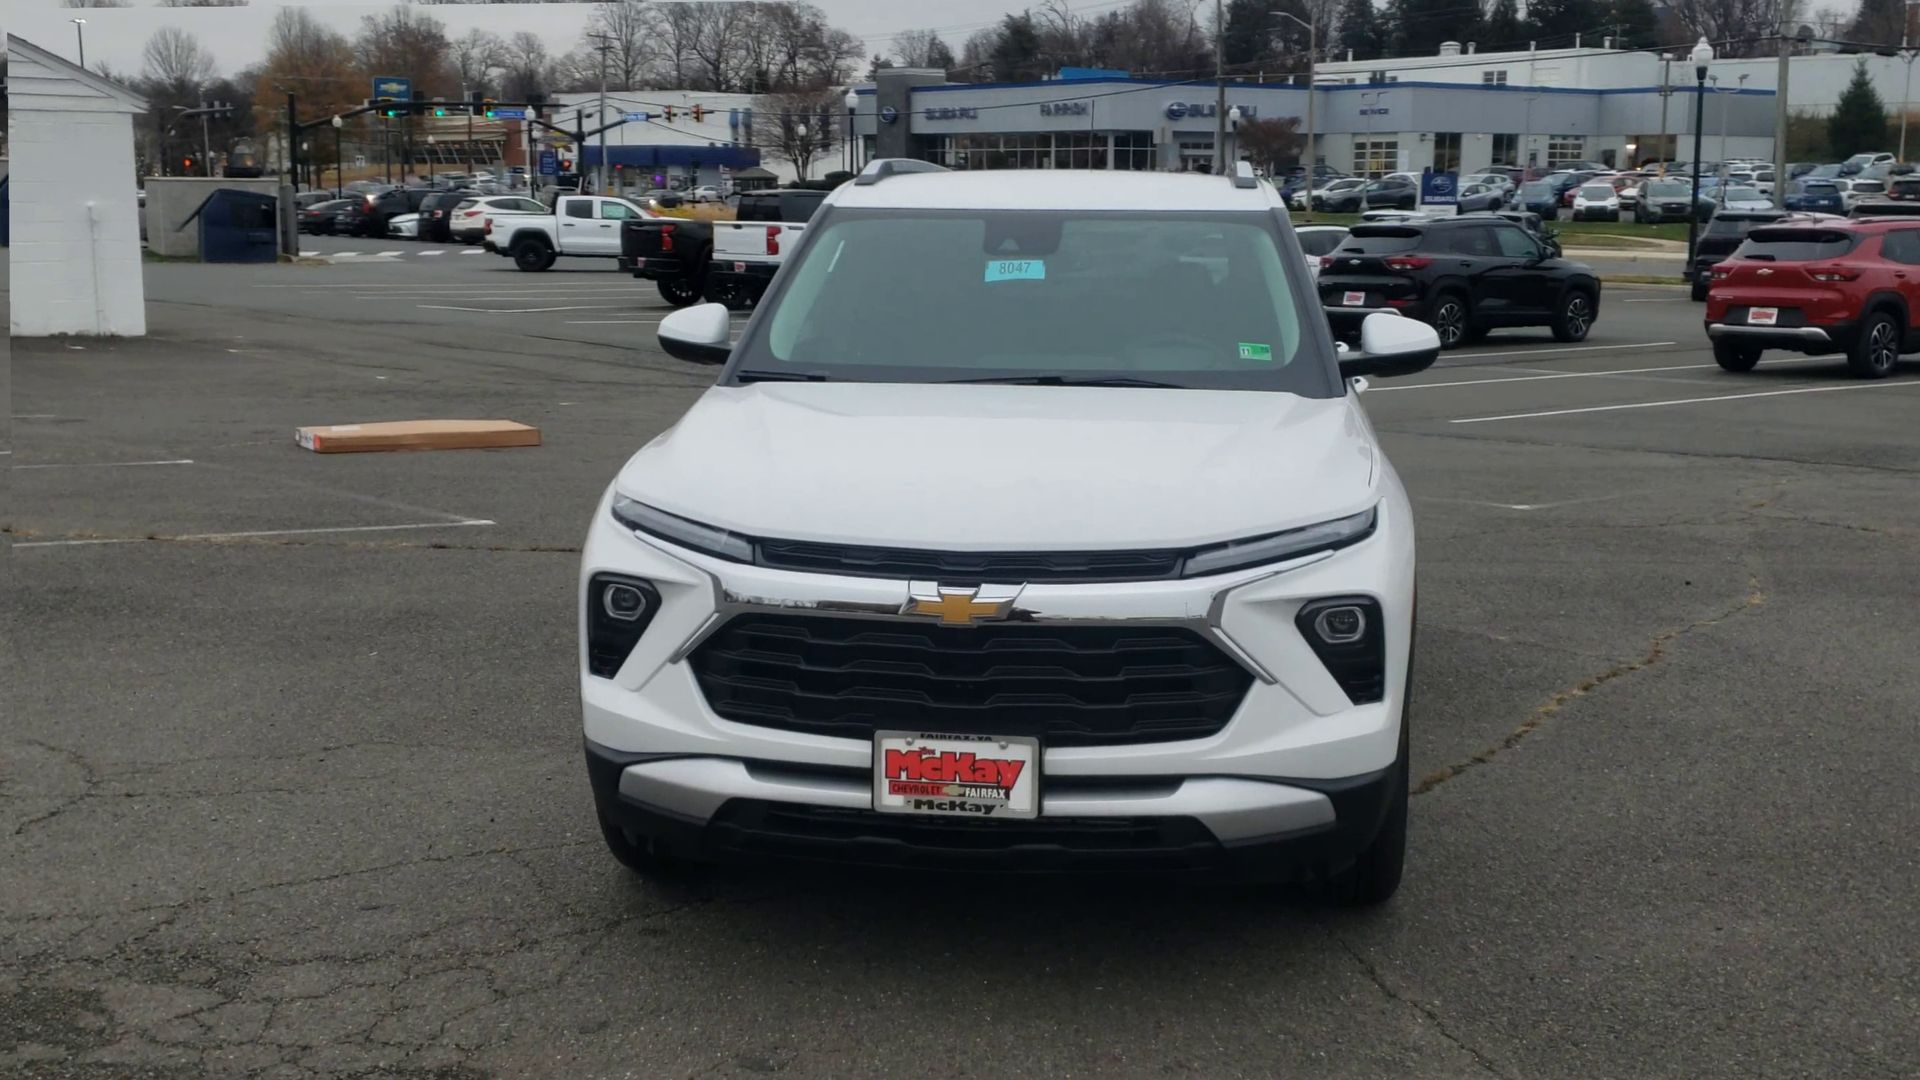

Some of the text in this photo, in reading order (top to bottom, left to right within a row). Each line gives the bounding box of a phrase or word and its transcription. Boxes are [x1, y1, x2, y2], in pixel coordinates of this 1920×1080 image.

[999, 261, 1031, 275] 8047
[884, 748, 1026, 790] McKay
[892, 783, 1006, 799] CHEVROLET FAIRFAX
[913, 799, 997, 815] McKay
